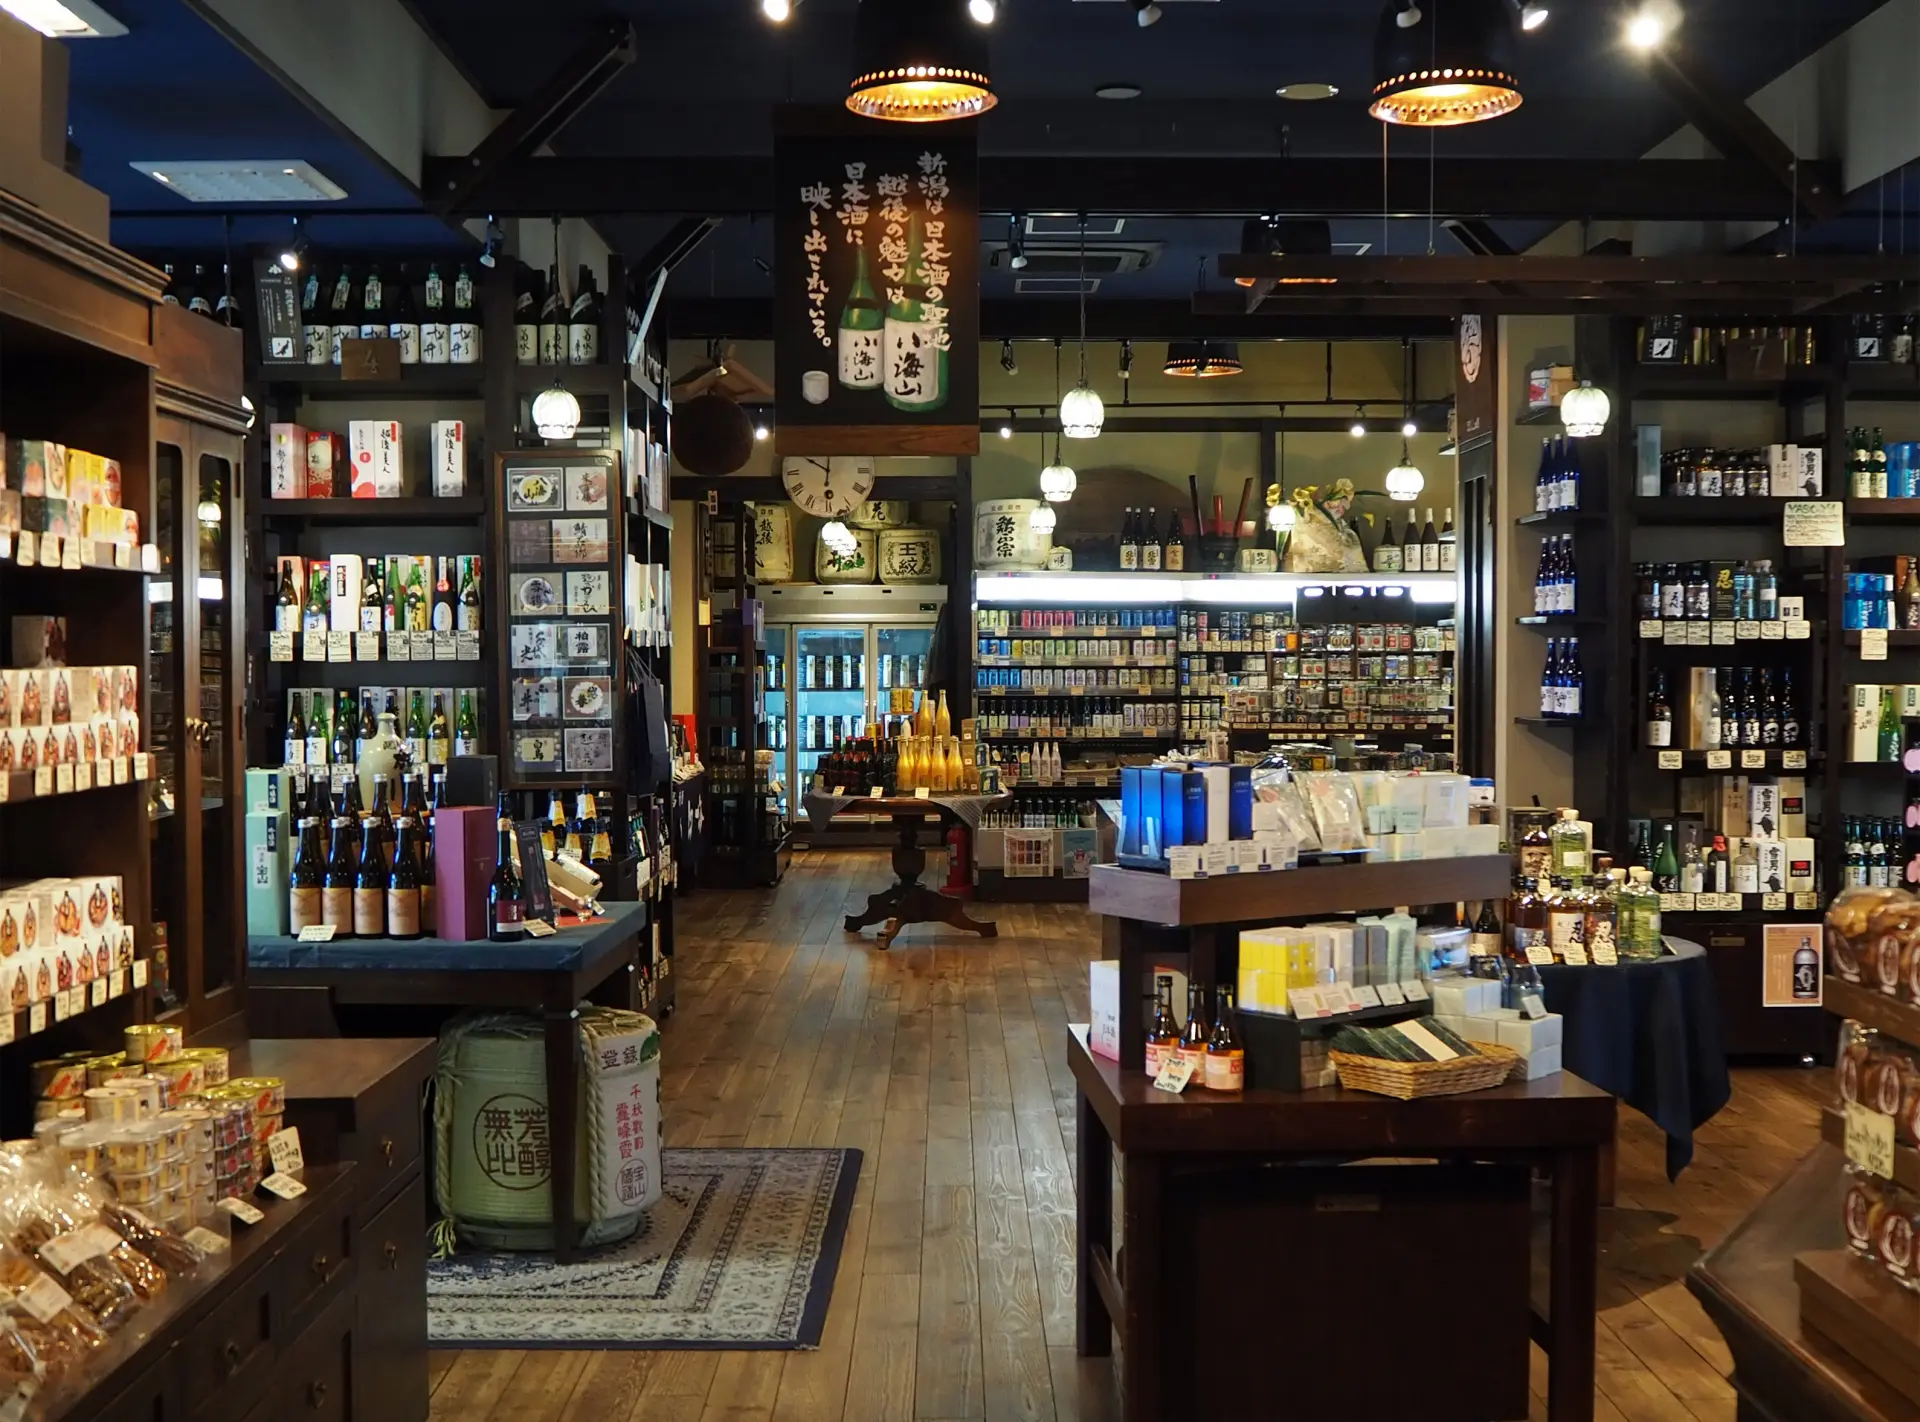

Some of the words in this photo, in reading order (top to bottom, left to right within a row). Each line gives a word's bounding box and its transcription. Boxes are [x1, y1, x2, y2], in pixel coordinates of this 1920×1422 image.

[836, 162, 870, 245] 日本酒に
[800, 181, 832, 347] 映し出されている。
[877, 173, 910, 304] 越後の魅力は
[759, 518, 774, 544] 越後
[898, 543, 917, 576] 王紋
[1716, 569, 1734, 589] 忍
[483, 1108, 516, 1177] 無比
